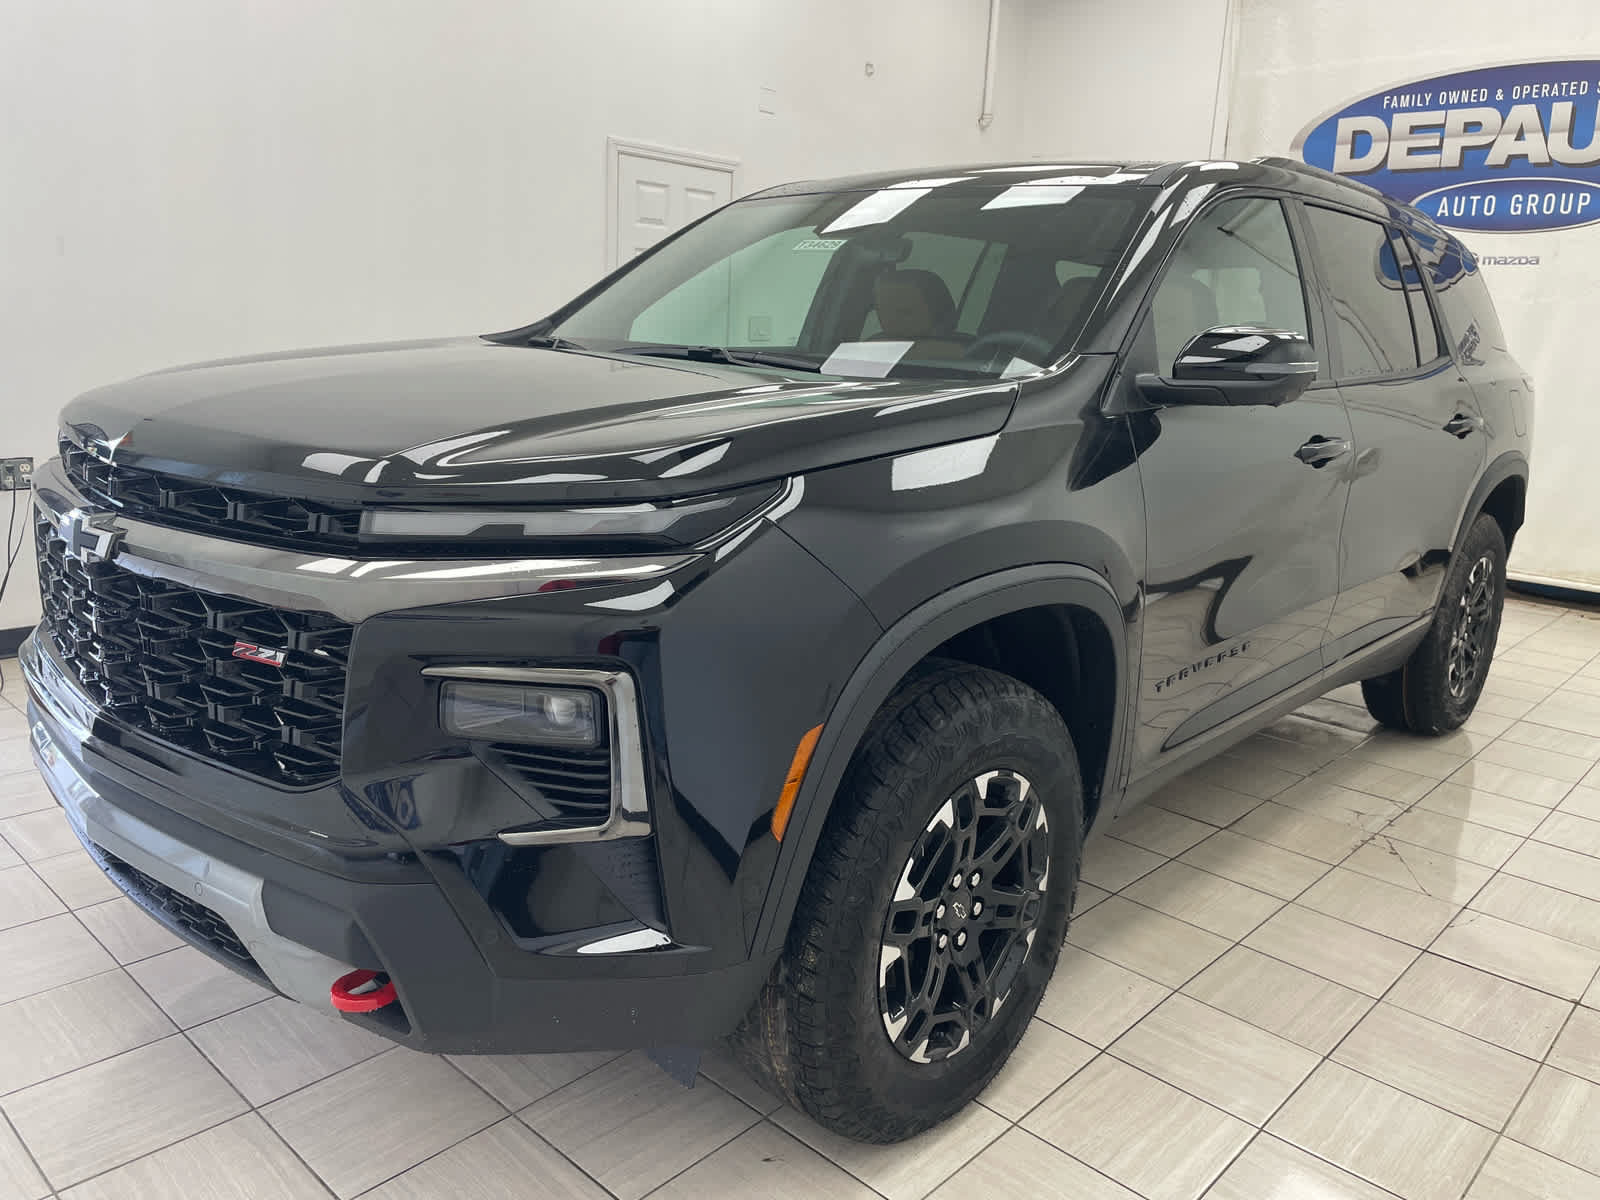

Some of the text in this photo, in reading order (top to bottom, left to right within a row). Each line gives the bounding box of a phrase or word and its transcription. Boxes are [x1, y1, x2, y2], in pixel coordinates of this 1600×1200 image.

[1383, 92, 1432, 110] FAMILY
[1439, 88, 1488, 105] OWNED
[1495, 87, 1504, 101] &
[1512, 80, 1589, 100] OPERATED
[1333, 100, 1600, 175] DEPAU
[1437, 192, 1591, 217] AUTO GROUP
[1482, 255, 1540, 266] mazda
